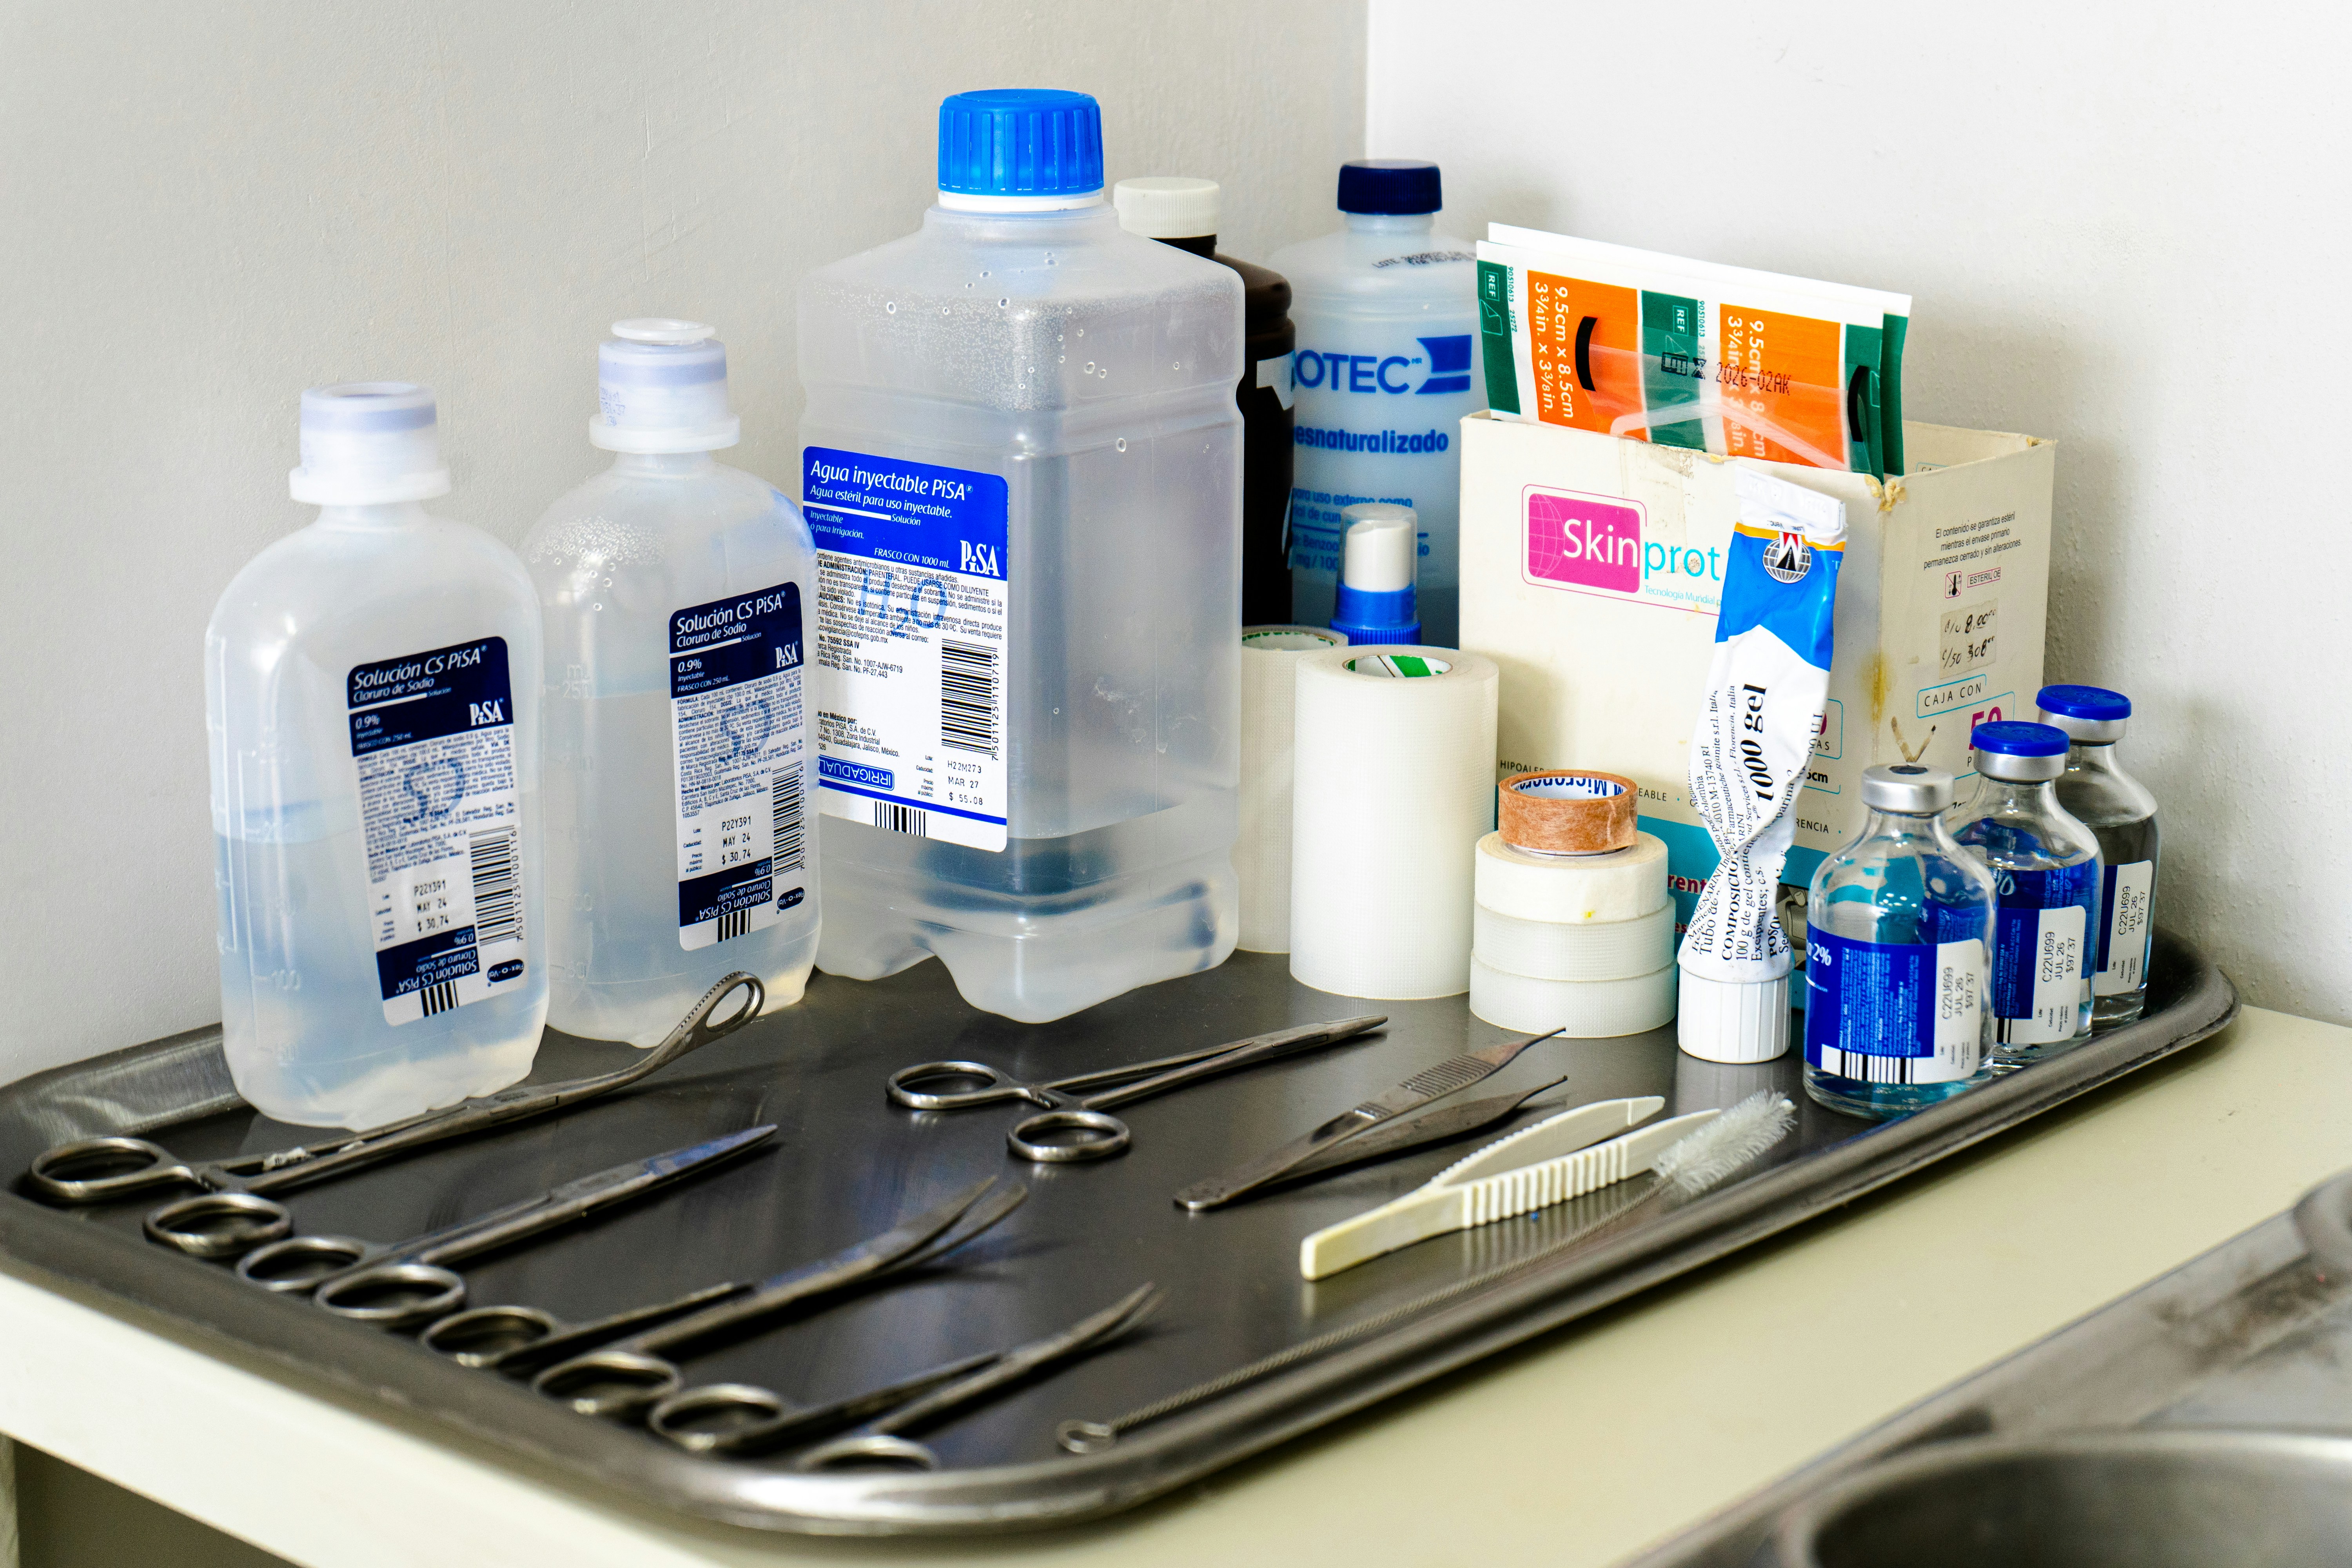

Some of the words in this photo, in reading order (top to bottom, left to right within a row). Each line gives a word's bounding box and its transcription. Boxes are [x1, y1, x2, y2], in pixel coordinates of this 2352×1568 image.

[1509, 310, 1517, 332] 25272
[1555, 287, 1569, 341] 9.5cm
[1677, 309, 1685, 332] REF
[1539, 343, 1548, 354] x
[1557, 347, 1566, 358] x
[1296, 349, 1410, 394] OTEC
[1558, 363, 1573, 418] 8.5cm
[1295, 426, 1449, 454] esnaturalizado
[811, 460, 849, 484] Agua
[853, 466, 928, 495] inyectable
[810, 485, 833, 499] Agua
[835, 488, 860, 503] estéril
[863, 495, 883, 507] para
[886, 497, 901, 510] uso
[904, 502, 951, 517] inyectable.
[1313, 489, 1331, 505] uso
[810, 510, 843, 525] Inyectable
[891, 514, 921, 526] Solución
[1936, 529, 1942, 538] El
[1943, 524, 1969, 537] contenido
[1978, 517, 2000, 531] garantiza
[2001, 511, 2015, 523] estéril
[816, 523, 830, 534] para
[832, 526, 863, 539] Irrigación.
[1941, 540, 1964, 550] mientras
[1966, 537, 1970, 546] el
[1972, 534, 1989, 544] envase
[1991, 528, 2010, 541] primario
[874, 547, 903, 560] FRASCO
[904, 553, 920, 563] CON
[922, 556, 938, 566] 1000
[940, 559, 949, 568] mL
[1563, 518, 1720, 581] Skinprot
[1924, 555, 1958, 570] permanezca
[1960, 550, 1979, 561] cerrado
[1980, 549, 1983, 559] y
[1993, 539, 2021, 553] alteraciones.
[817, 552, 833, 561] ontiene
[834, 556, 851, 566] agentes
[853, 559, 889, 571] antimicrobianos
[909, 568, 933, 579] sustancias
[935, 573, 958, 583] añadidas.
[1969, 572, 1992, 584] ESTERIL
[824, 561, 867, 575] ADMINISTRACIÓN:
[869, 569, 902, 581] PARENTERAL.
[904, 575, 920, 584] PUEDE
[922, 578, 942, 588] USARSE
[944, 582, 959, 592] COMO
[961, 585, 989, 597] DILUYENTE
[1645, 584, 1684, 601] Tecnología
[1686, 592, 1715, 605] Mundial
[677, 609, 733, 635] Solución
[737, 601, 753, 620] CS
[676, 629, 710, 650] Cloruro
[711, 627, 721, 639] de
[723, 621, 746, 637] Sodio
[742, 630, 761, 642] Solución
[828, 636, 841, 645] 75592
[843, 639, 853, 647] SSA
[354, 661, 421, 690] Solución
[425, 655, 444, 675] CS
[678, 656, 702, 674] 0.9%
[352, 684, 389, 704] Cloruro
[391, 682, 405, 695] de
[407, 675, 435, 692] Sodio
[677, 681, 699, 694] FRASCO
[700, 679, 711, 688] CON
[713, 677, 721, 685] 250
[1924, 691, 1953, 706] CAJA
[1960, 683, 1981, 698] CON
[1743, 684, 1767, 733] gel
[1711, 716, 1719, 735] s.r.l.
[833, 737, 861, 750] Guadalajara,
[862, 743, 880, 753] Jalisco,
[881, 747, 899, 757] México.
[1701, 746, 1710, 756] R1
[820, 759, 891, 786] IRRIGADUAL
[947, 760, 982, 774] H22M273
[1740, 740, 1774, 801] 1000
[948, 776, 964, 786] MAR
[970, 780, 978, 788] 27
[1704, 759, 1719, 799] M-13740
[949, 791, 953, 801] $
[959, 794, 982, 806] 55.08
[1639, 788, 1666, 802] EABLE
[1695, 775, 1711, 817] Colombia
[1720, 773, 1735, 835] Farmaceutiche
[1741, 785, 1752, 821] Services
[722, 816, 751, 831] P22Y391
[723, 837, 735, 848] MAY
[742, 833, 750, 843] 24
[722, 854, 725, 866] $
[730, 849, 751, 862] 30.74
[1755, 866, 1766, 885] c.s.
[416, 900, 432, 915] MAY
[438, 898, 447, 909] 24
[721, 901, 731, 913] CS
[734, 889, 770, 909] Solución
[1743, 888, 1755, 908] gel
[2131, 896, 2138, 909] 26
[1740, 911, 1751, 926] de
[2118, 886, 2130, 935] C22U699
[1699, 919, 1716, 955] Tubo
[1736, 941, 1748, 960] 100
[2042, 931, 2054, 982] C22U699
[2056, 942, 2065, 956] 26
[2055, 959, 2063, 980] JUL
